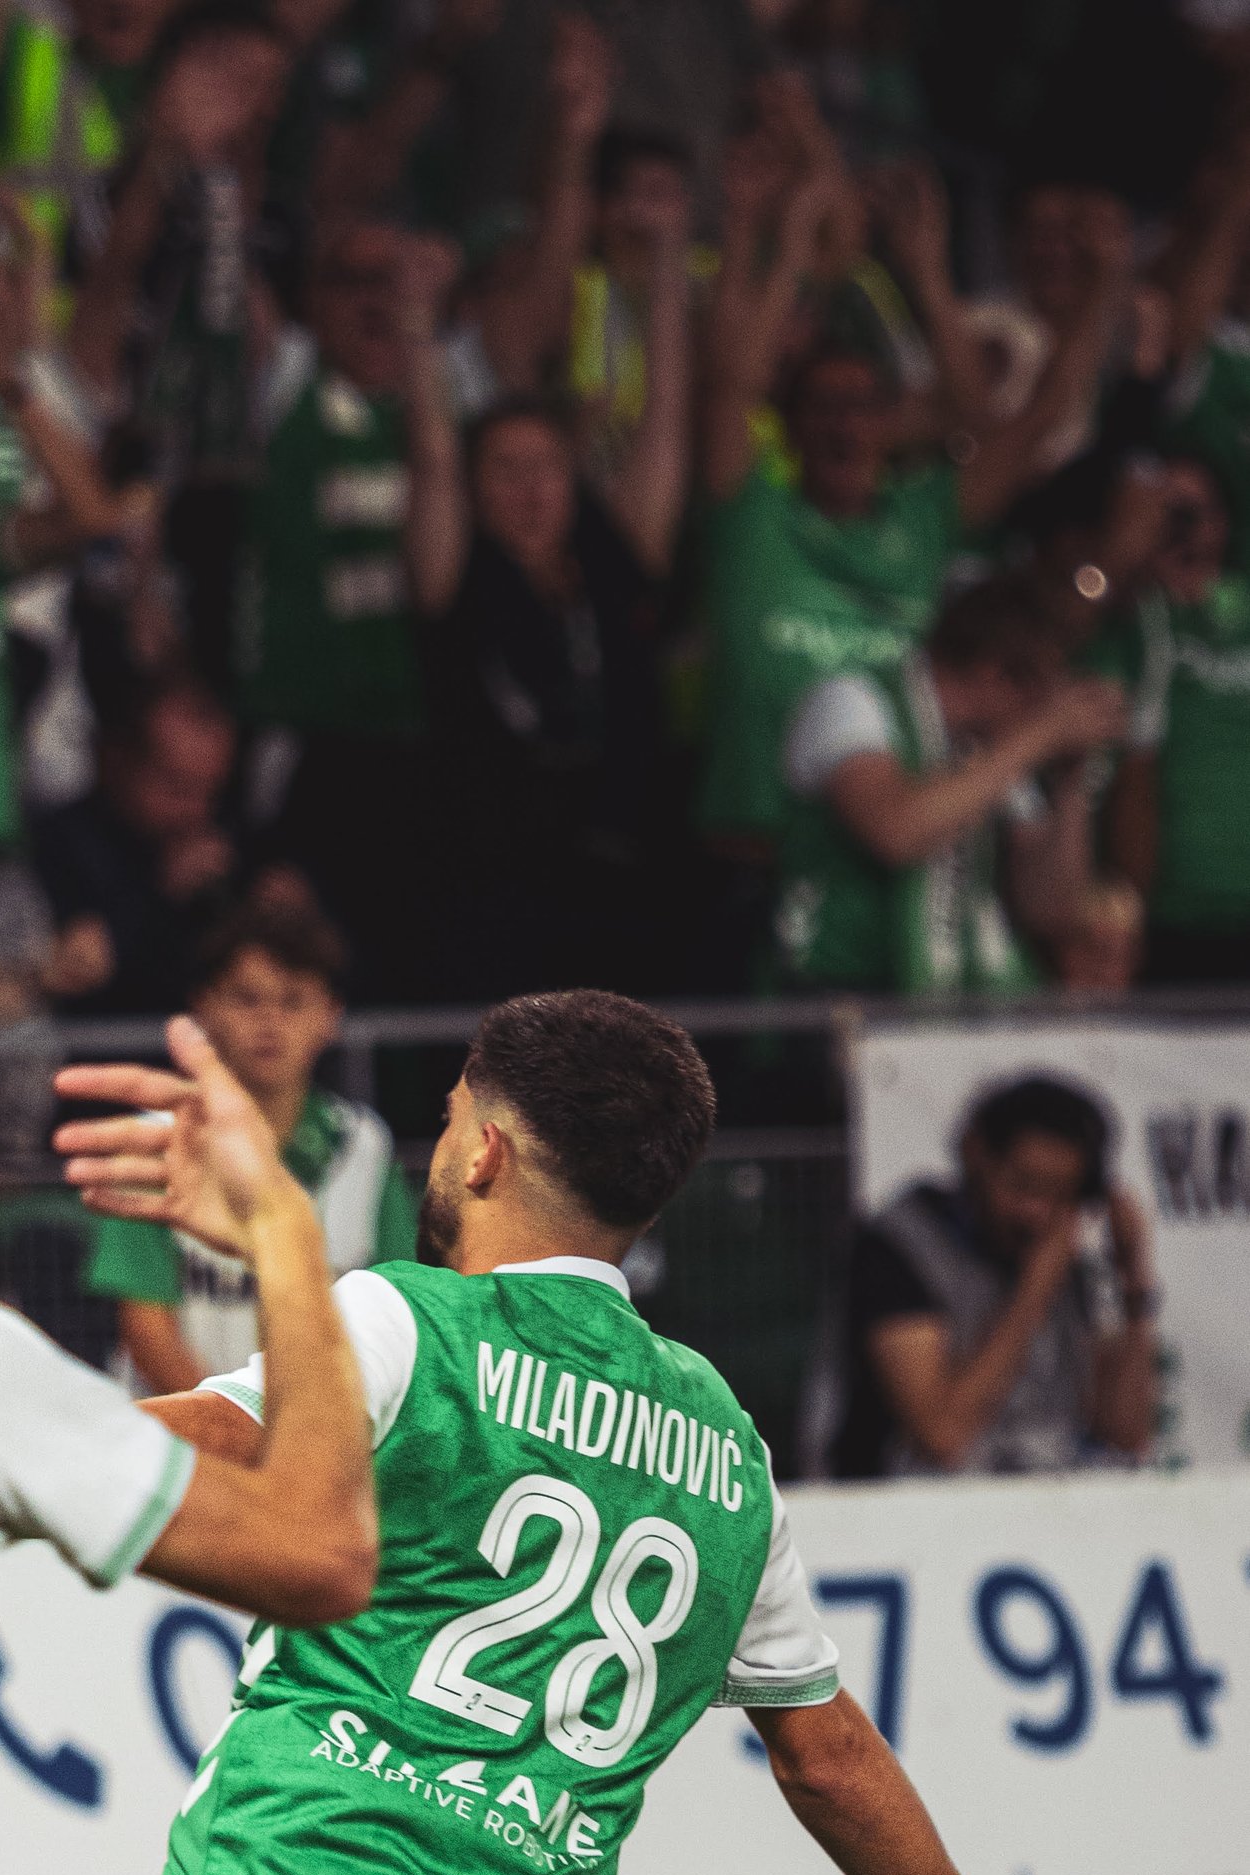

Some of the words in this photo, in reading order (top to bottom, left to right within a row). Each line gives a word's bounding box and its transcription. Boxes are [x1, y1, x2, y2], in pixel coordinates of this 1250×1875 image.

[477, 1341, 743, 1512] MILADINOVIĆ
[407, 1474, 698, 1768] 28
[972, 1555, 1226, 1756] 94
[309, 1739, 475, 1821] ADAPTIVE
